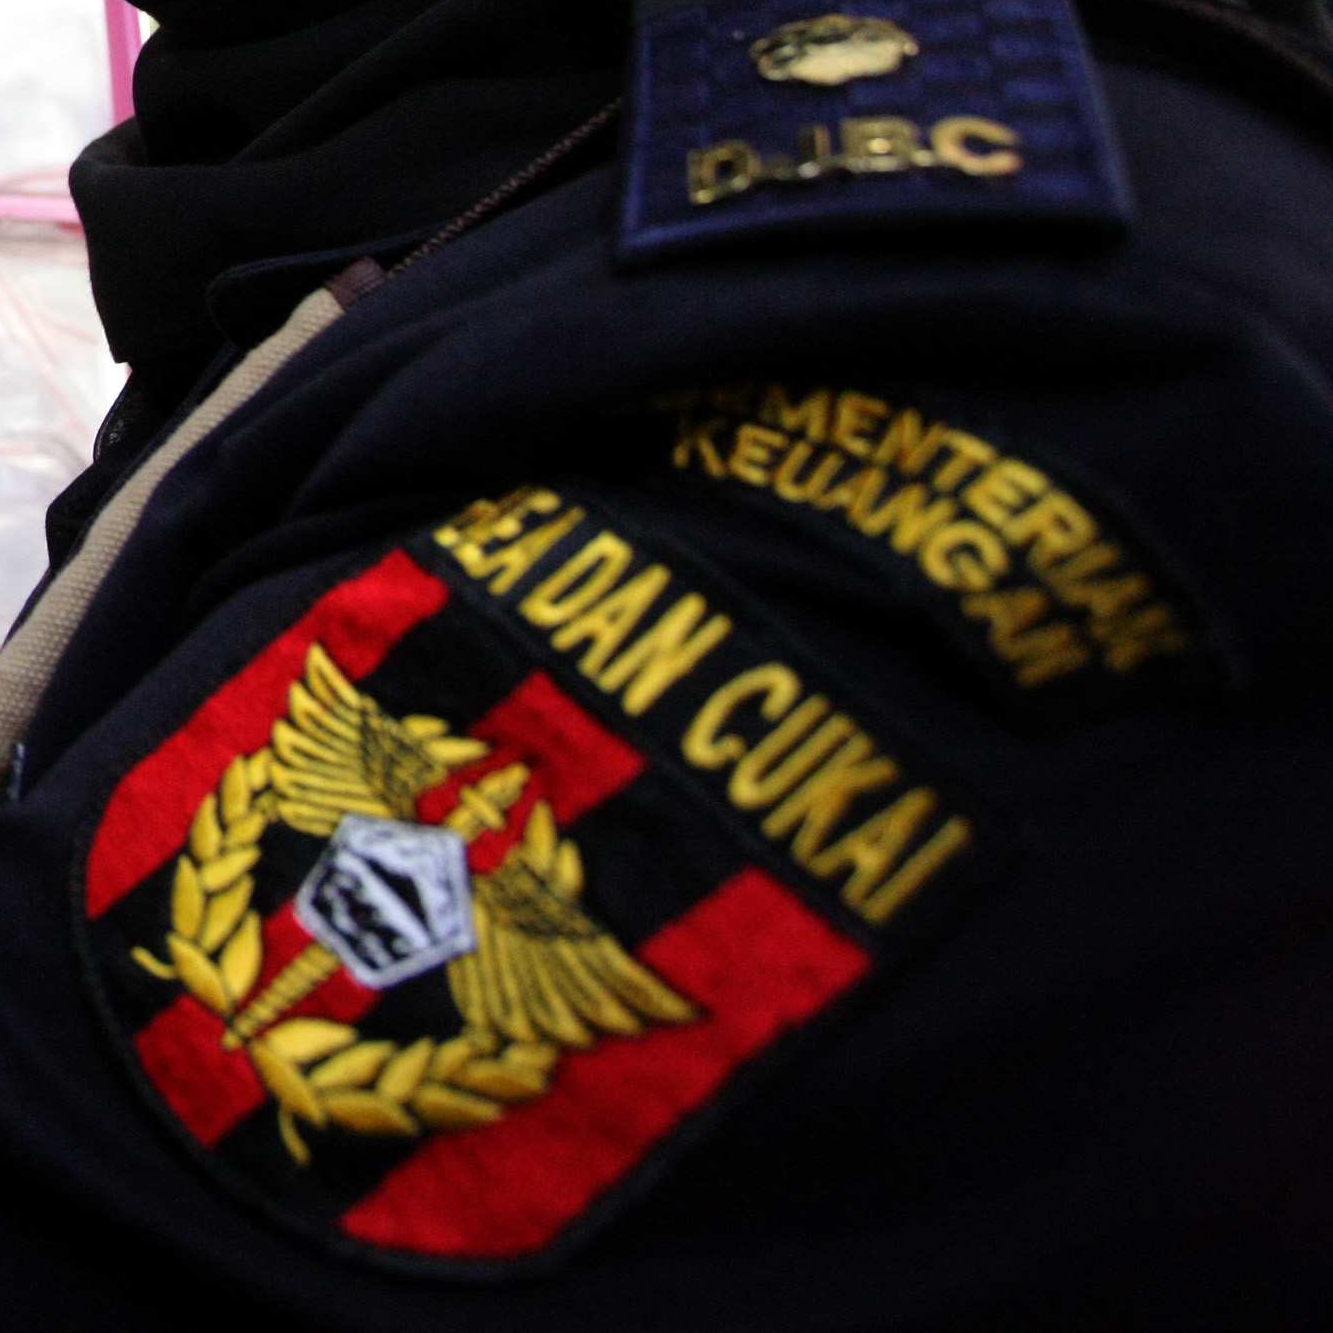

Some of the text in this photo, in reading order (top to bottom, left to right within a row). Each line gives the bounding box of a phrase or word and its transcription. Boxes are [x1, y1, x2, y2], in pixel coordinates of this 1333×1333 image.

[658, 382, 1191, 673] MENTERIAN
[671, 406, 1090, 688] KEUANGAN
[519, 528, 731, 718] DAN
[680, 662, 973, 925] CUKAI
